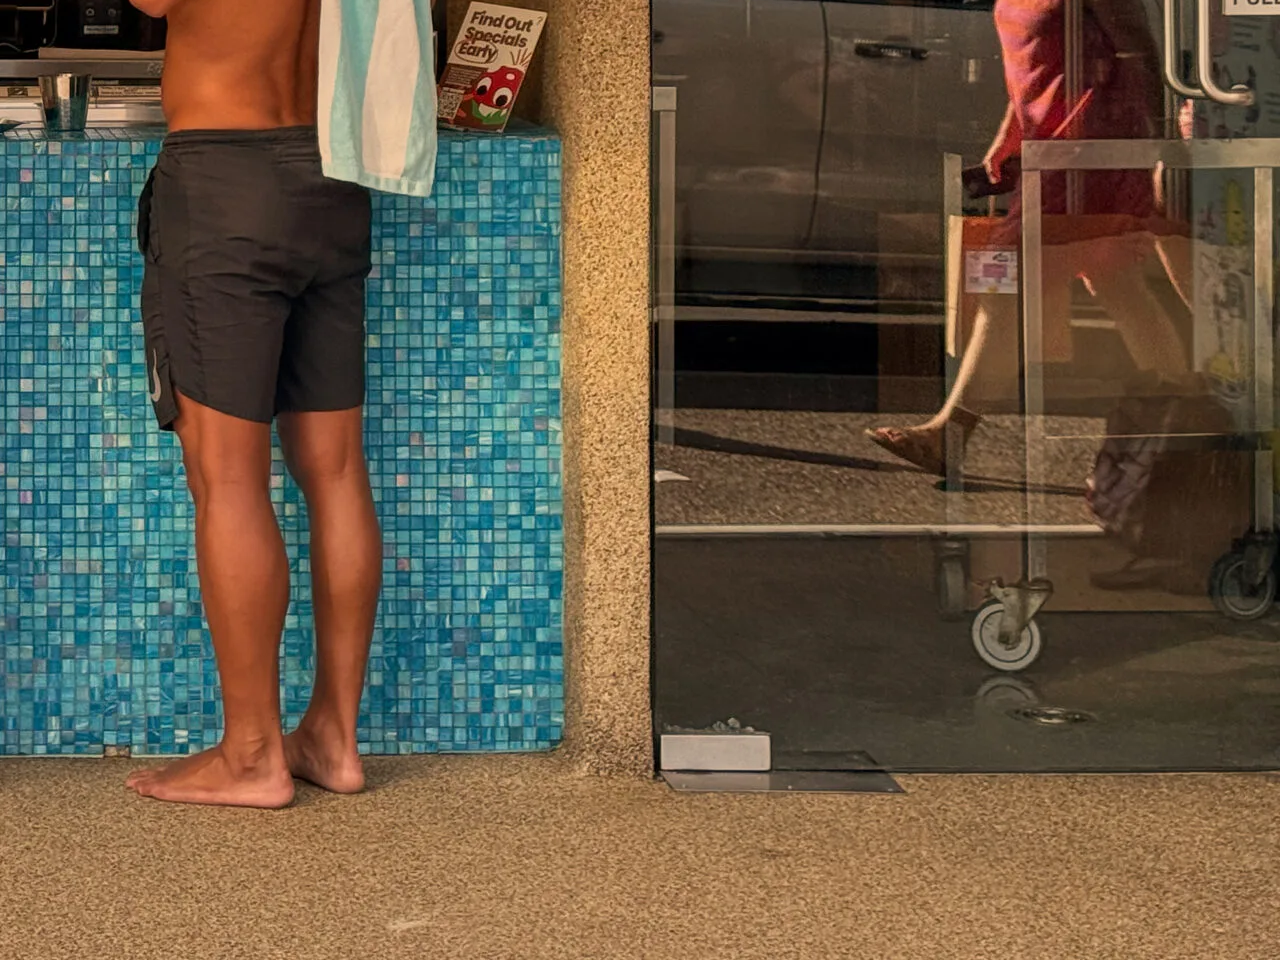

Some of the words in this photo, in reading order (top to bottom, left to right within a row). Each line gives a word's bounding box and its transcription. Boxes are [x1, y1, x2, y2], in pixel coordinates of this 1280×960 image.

[471, 10, 505, 28] Find
[504, 16, 534, 33] Out
[464, 26, 528, 48] Specials
[458, 42, 497, 63] Early
